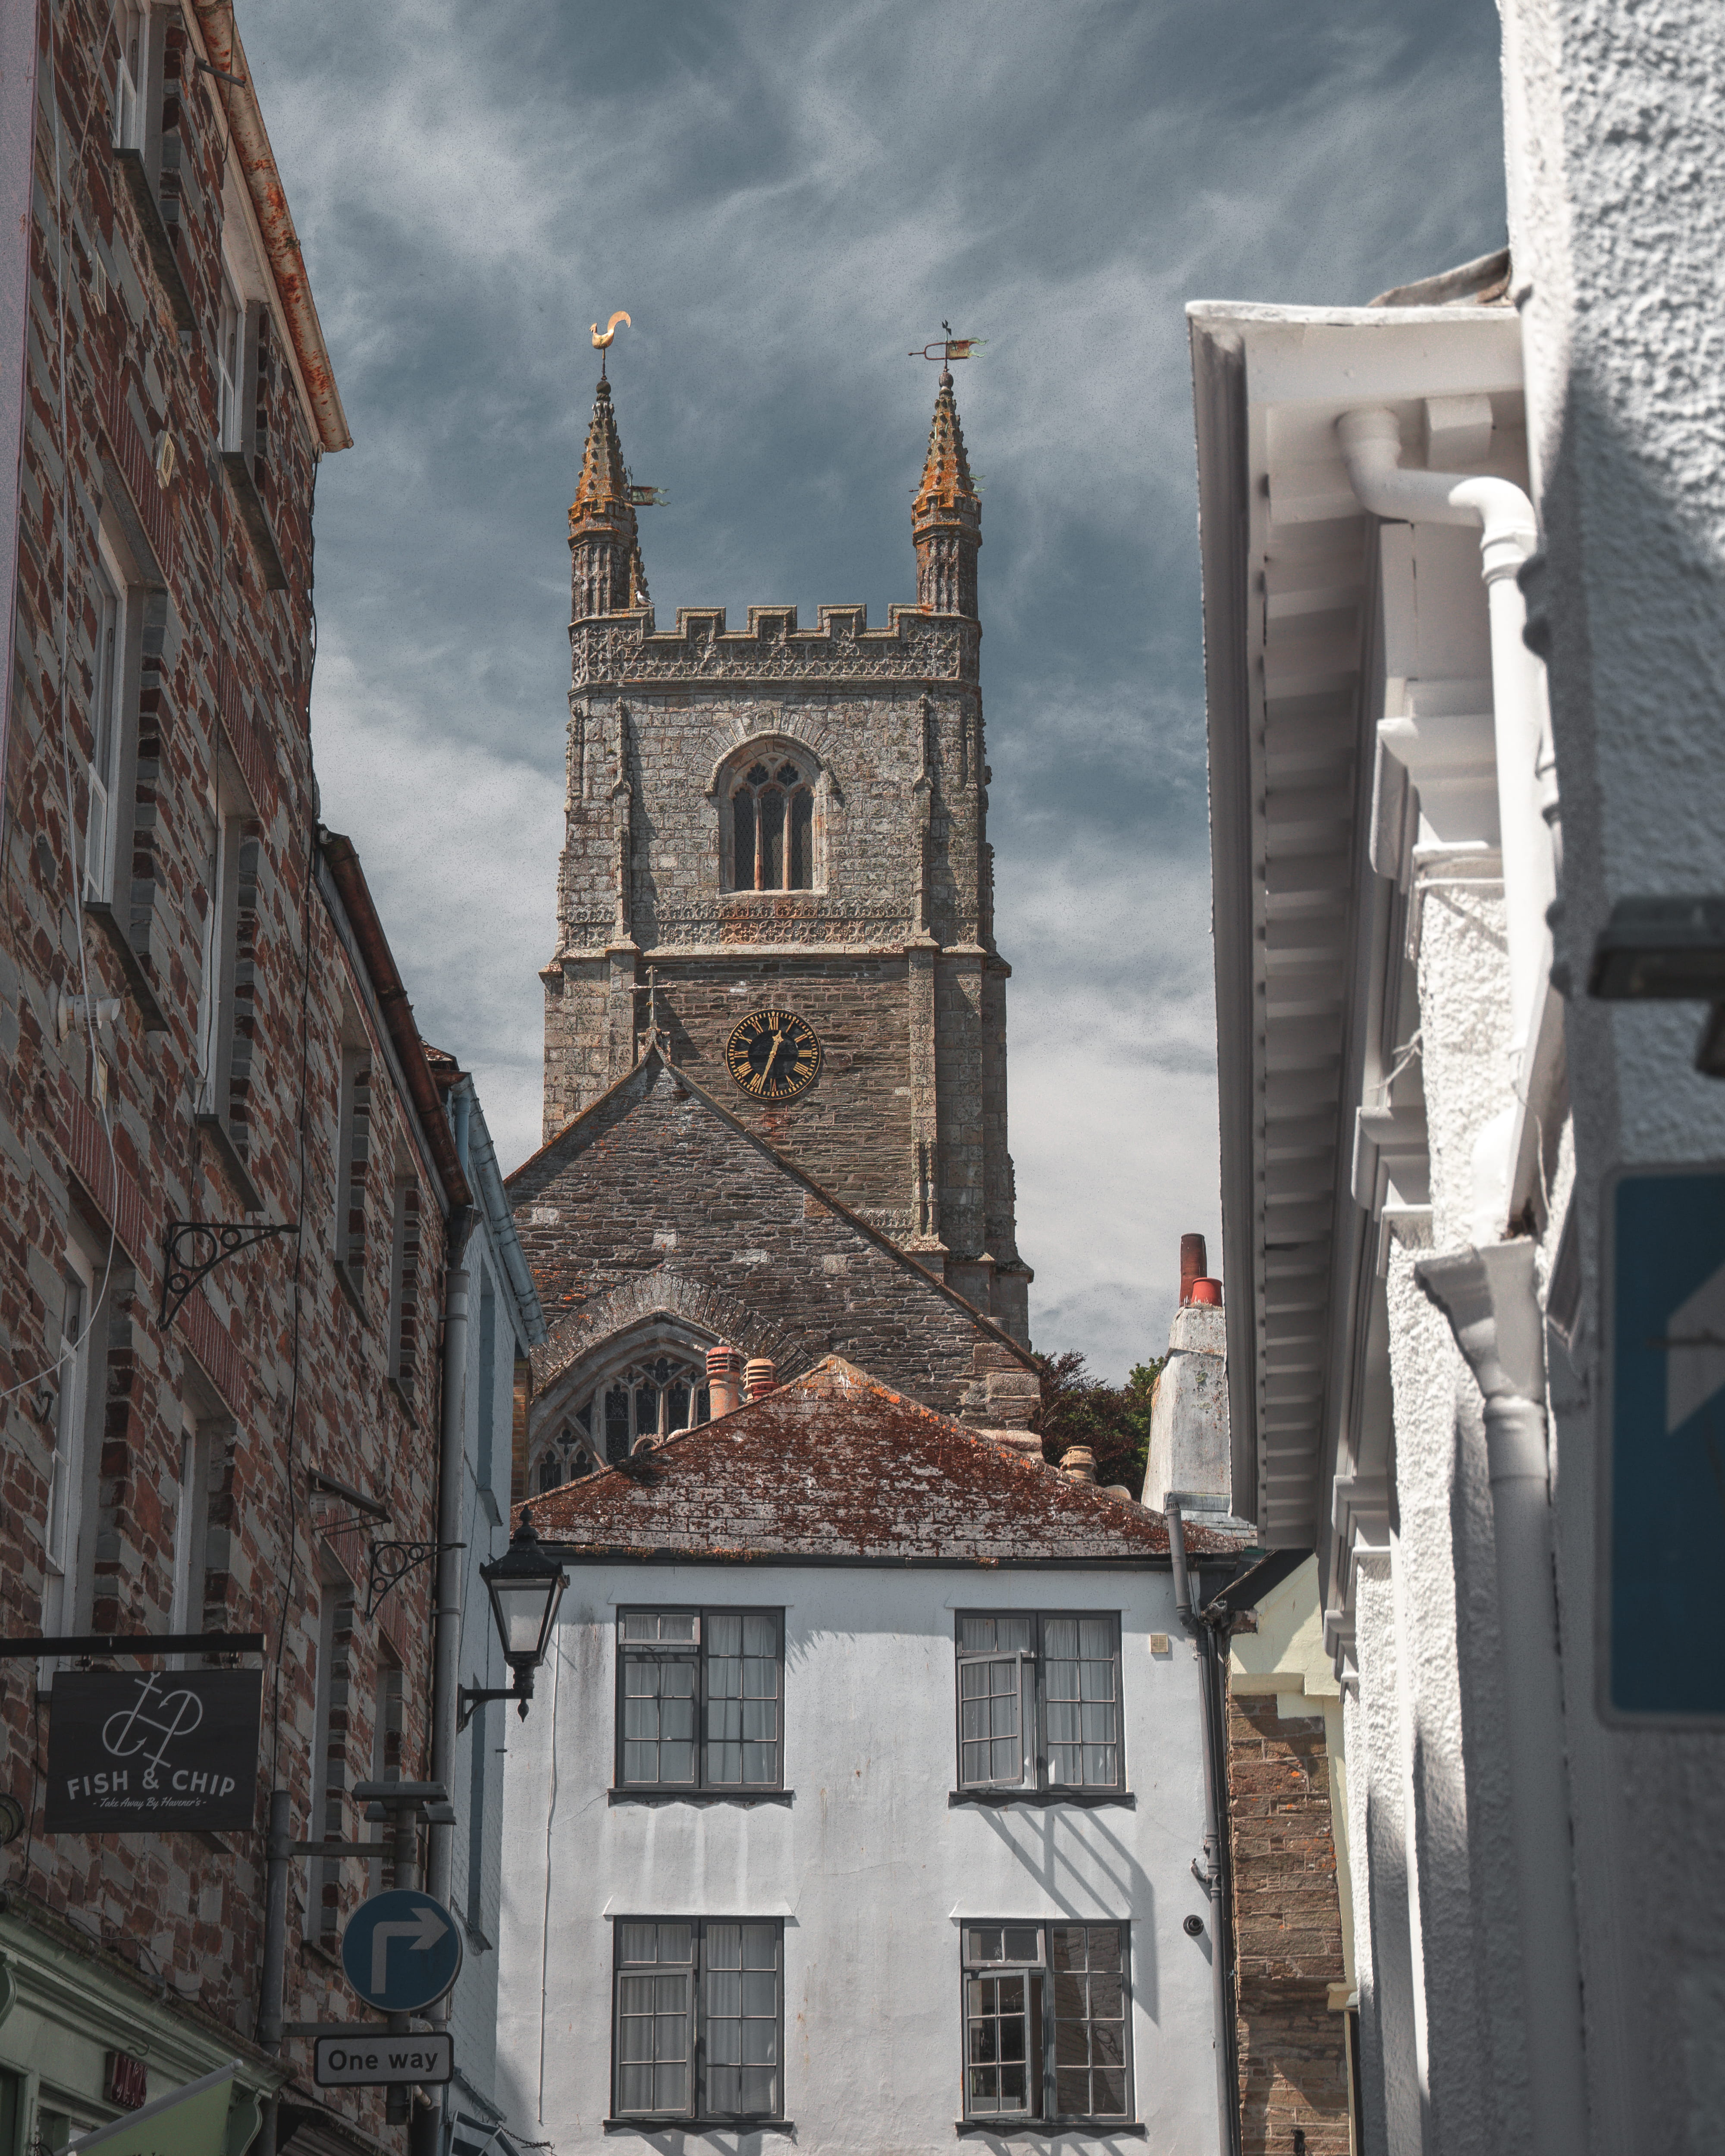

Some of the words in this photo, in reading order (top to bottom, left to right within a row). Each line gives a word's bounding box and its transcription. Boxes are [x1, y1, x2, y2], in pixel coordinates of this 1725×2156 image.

[768, 1016, 778, 1030] XII
[67, 1770, 128, 1800] FISH
[142, 1768, 160, 1789] &
[172, 1770, 235, 1797] CHIP
[100, 1797, 119, 1808] Take
[120, 1797, 144, 1810] Away
[146, 1797, 160, 1810] By
[160, 1797, 201, 1808] Havener's
[328, 2049, 379, 2071] One
[388, 2053, 438, 2072] way
